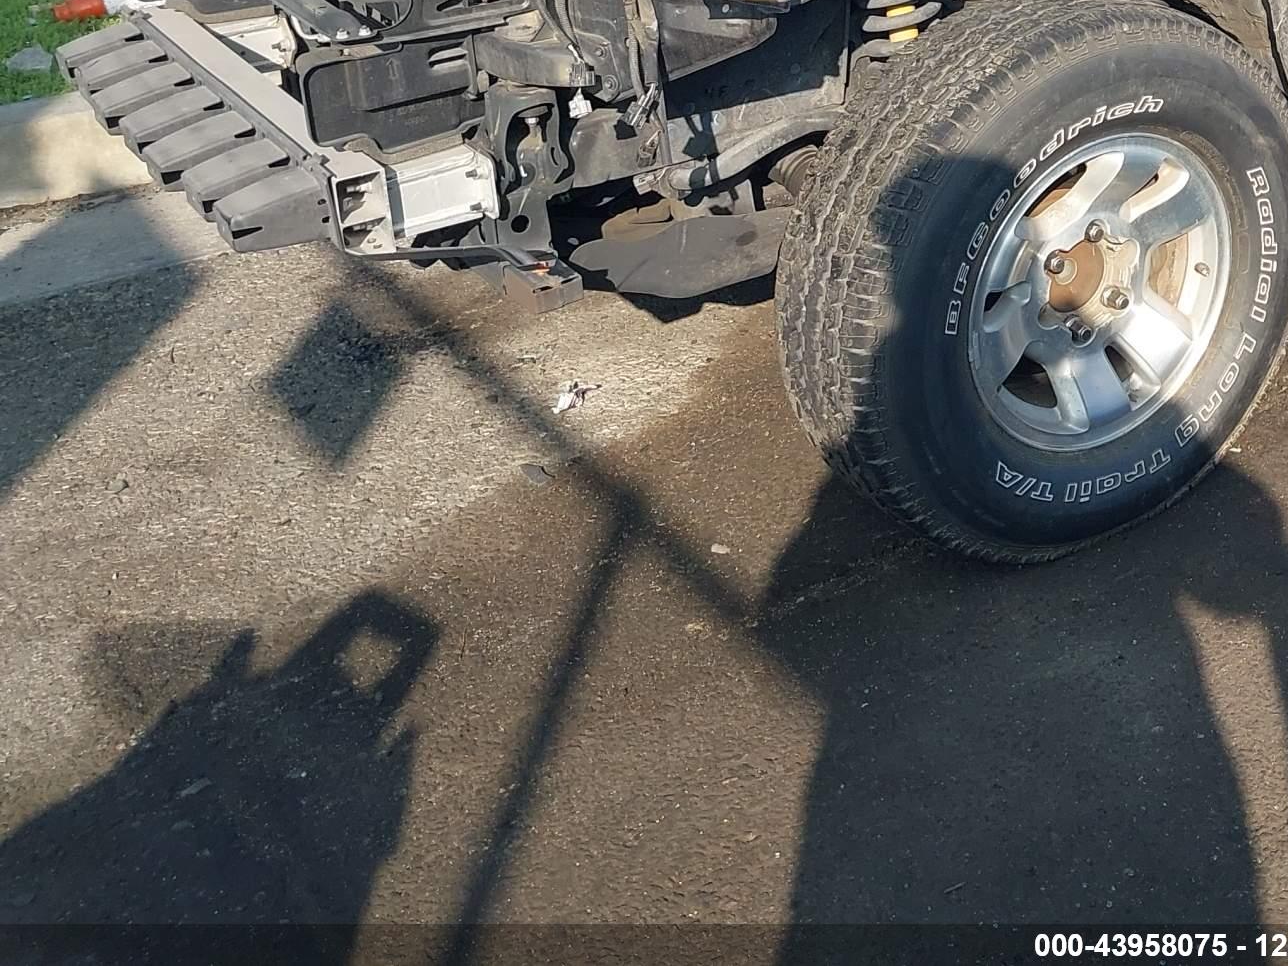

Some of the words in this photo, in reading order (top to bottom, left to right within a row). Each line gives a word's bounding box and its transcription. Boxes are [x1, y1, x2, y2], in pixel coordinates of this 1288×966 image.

[944, 94, 1164, 336] BFGoodrich
[1247, 166, 1279, 324] Radial
[1174, 335, 1257, 448] Long
[995, 460, 1054, 502] T/A
[1063, 448, 1172, 504] Trail
